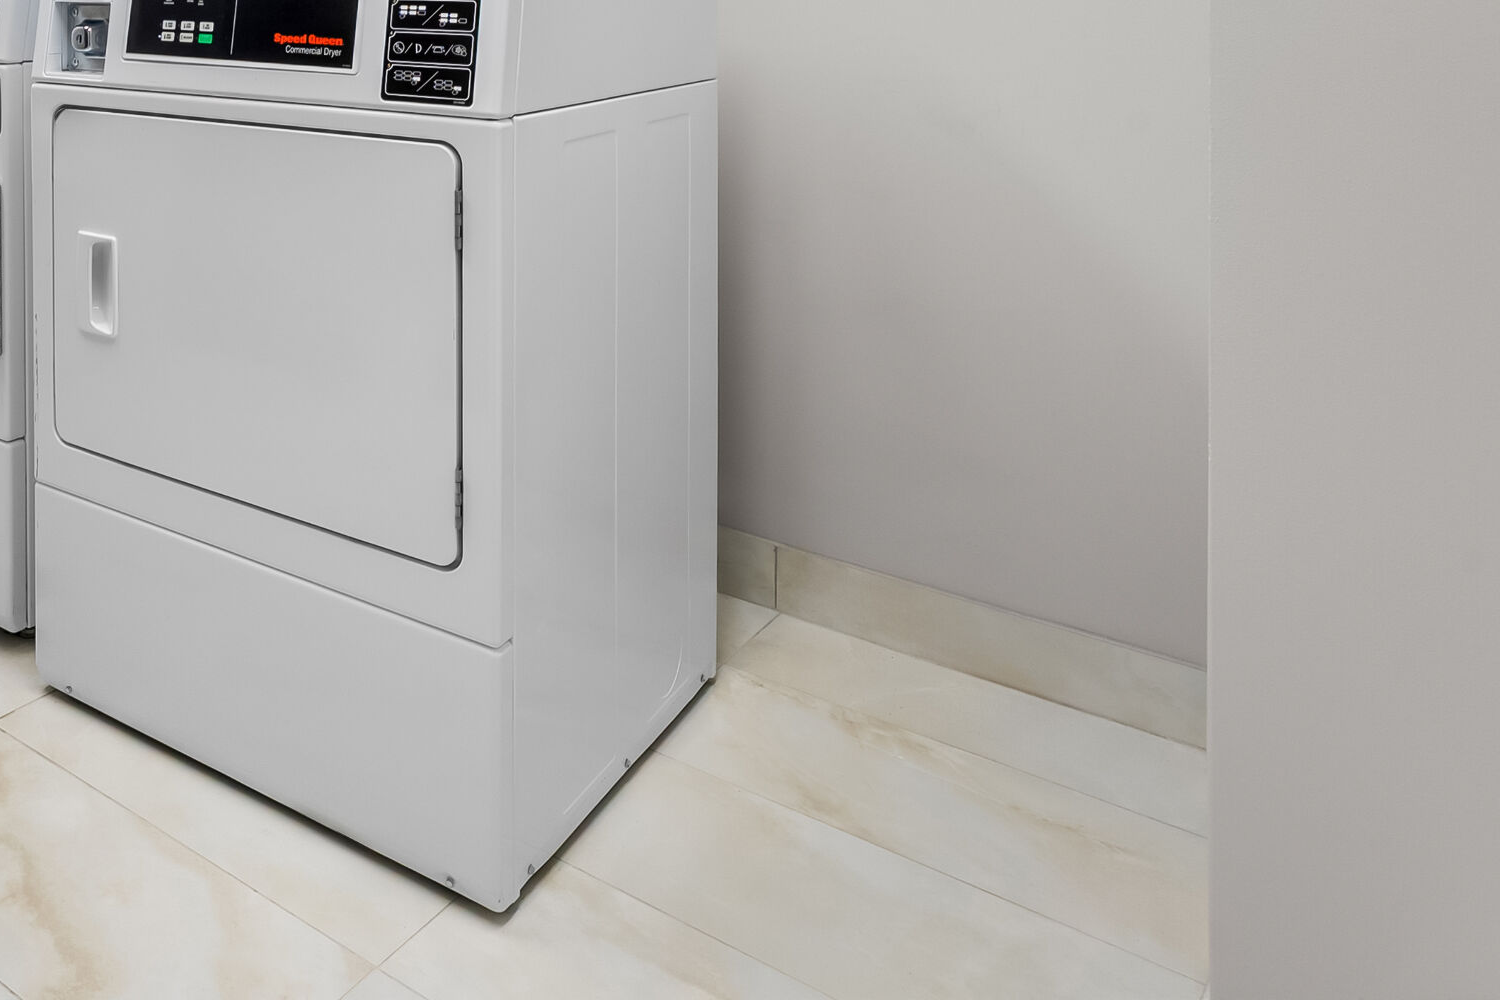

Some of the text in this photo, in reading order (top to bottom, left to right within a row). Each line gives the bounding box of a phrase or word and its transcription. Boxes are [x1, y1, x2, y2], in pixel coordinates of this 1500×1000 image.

[273, 32, 343, 46] Speed Queen
[285, 45, 342, 59] Commercial Dryer
